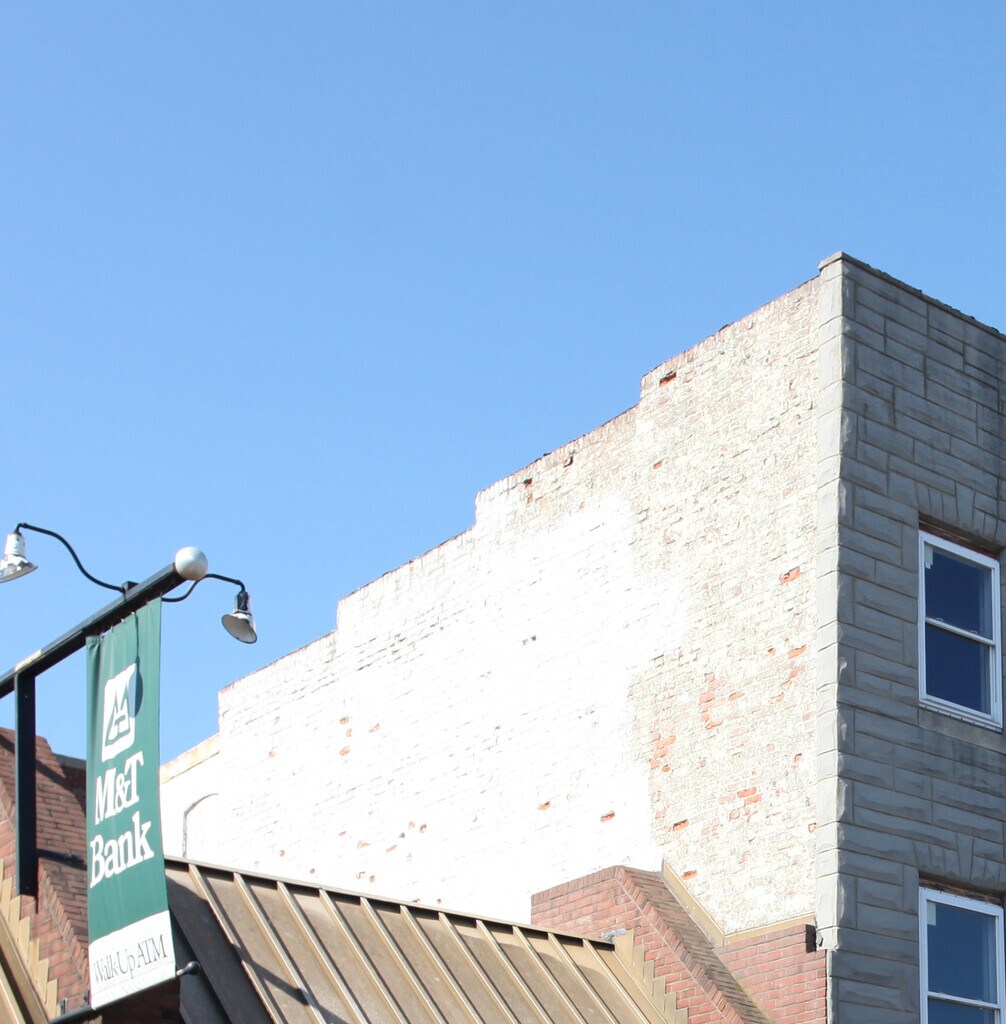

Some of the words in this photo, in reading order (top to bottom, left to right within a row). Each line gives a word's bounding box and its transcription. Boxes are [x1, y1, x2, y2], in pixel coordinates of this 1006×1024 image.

[94, 751, 144, 826] M&T
[90, 810, 154, 889] Bank
[136, 934, 168, 968] ATM
